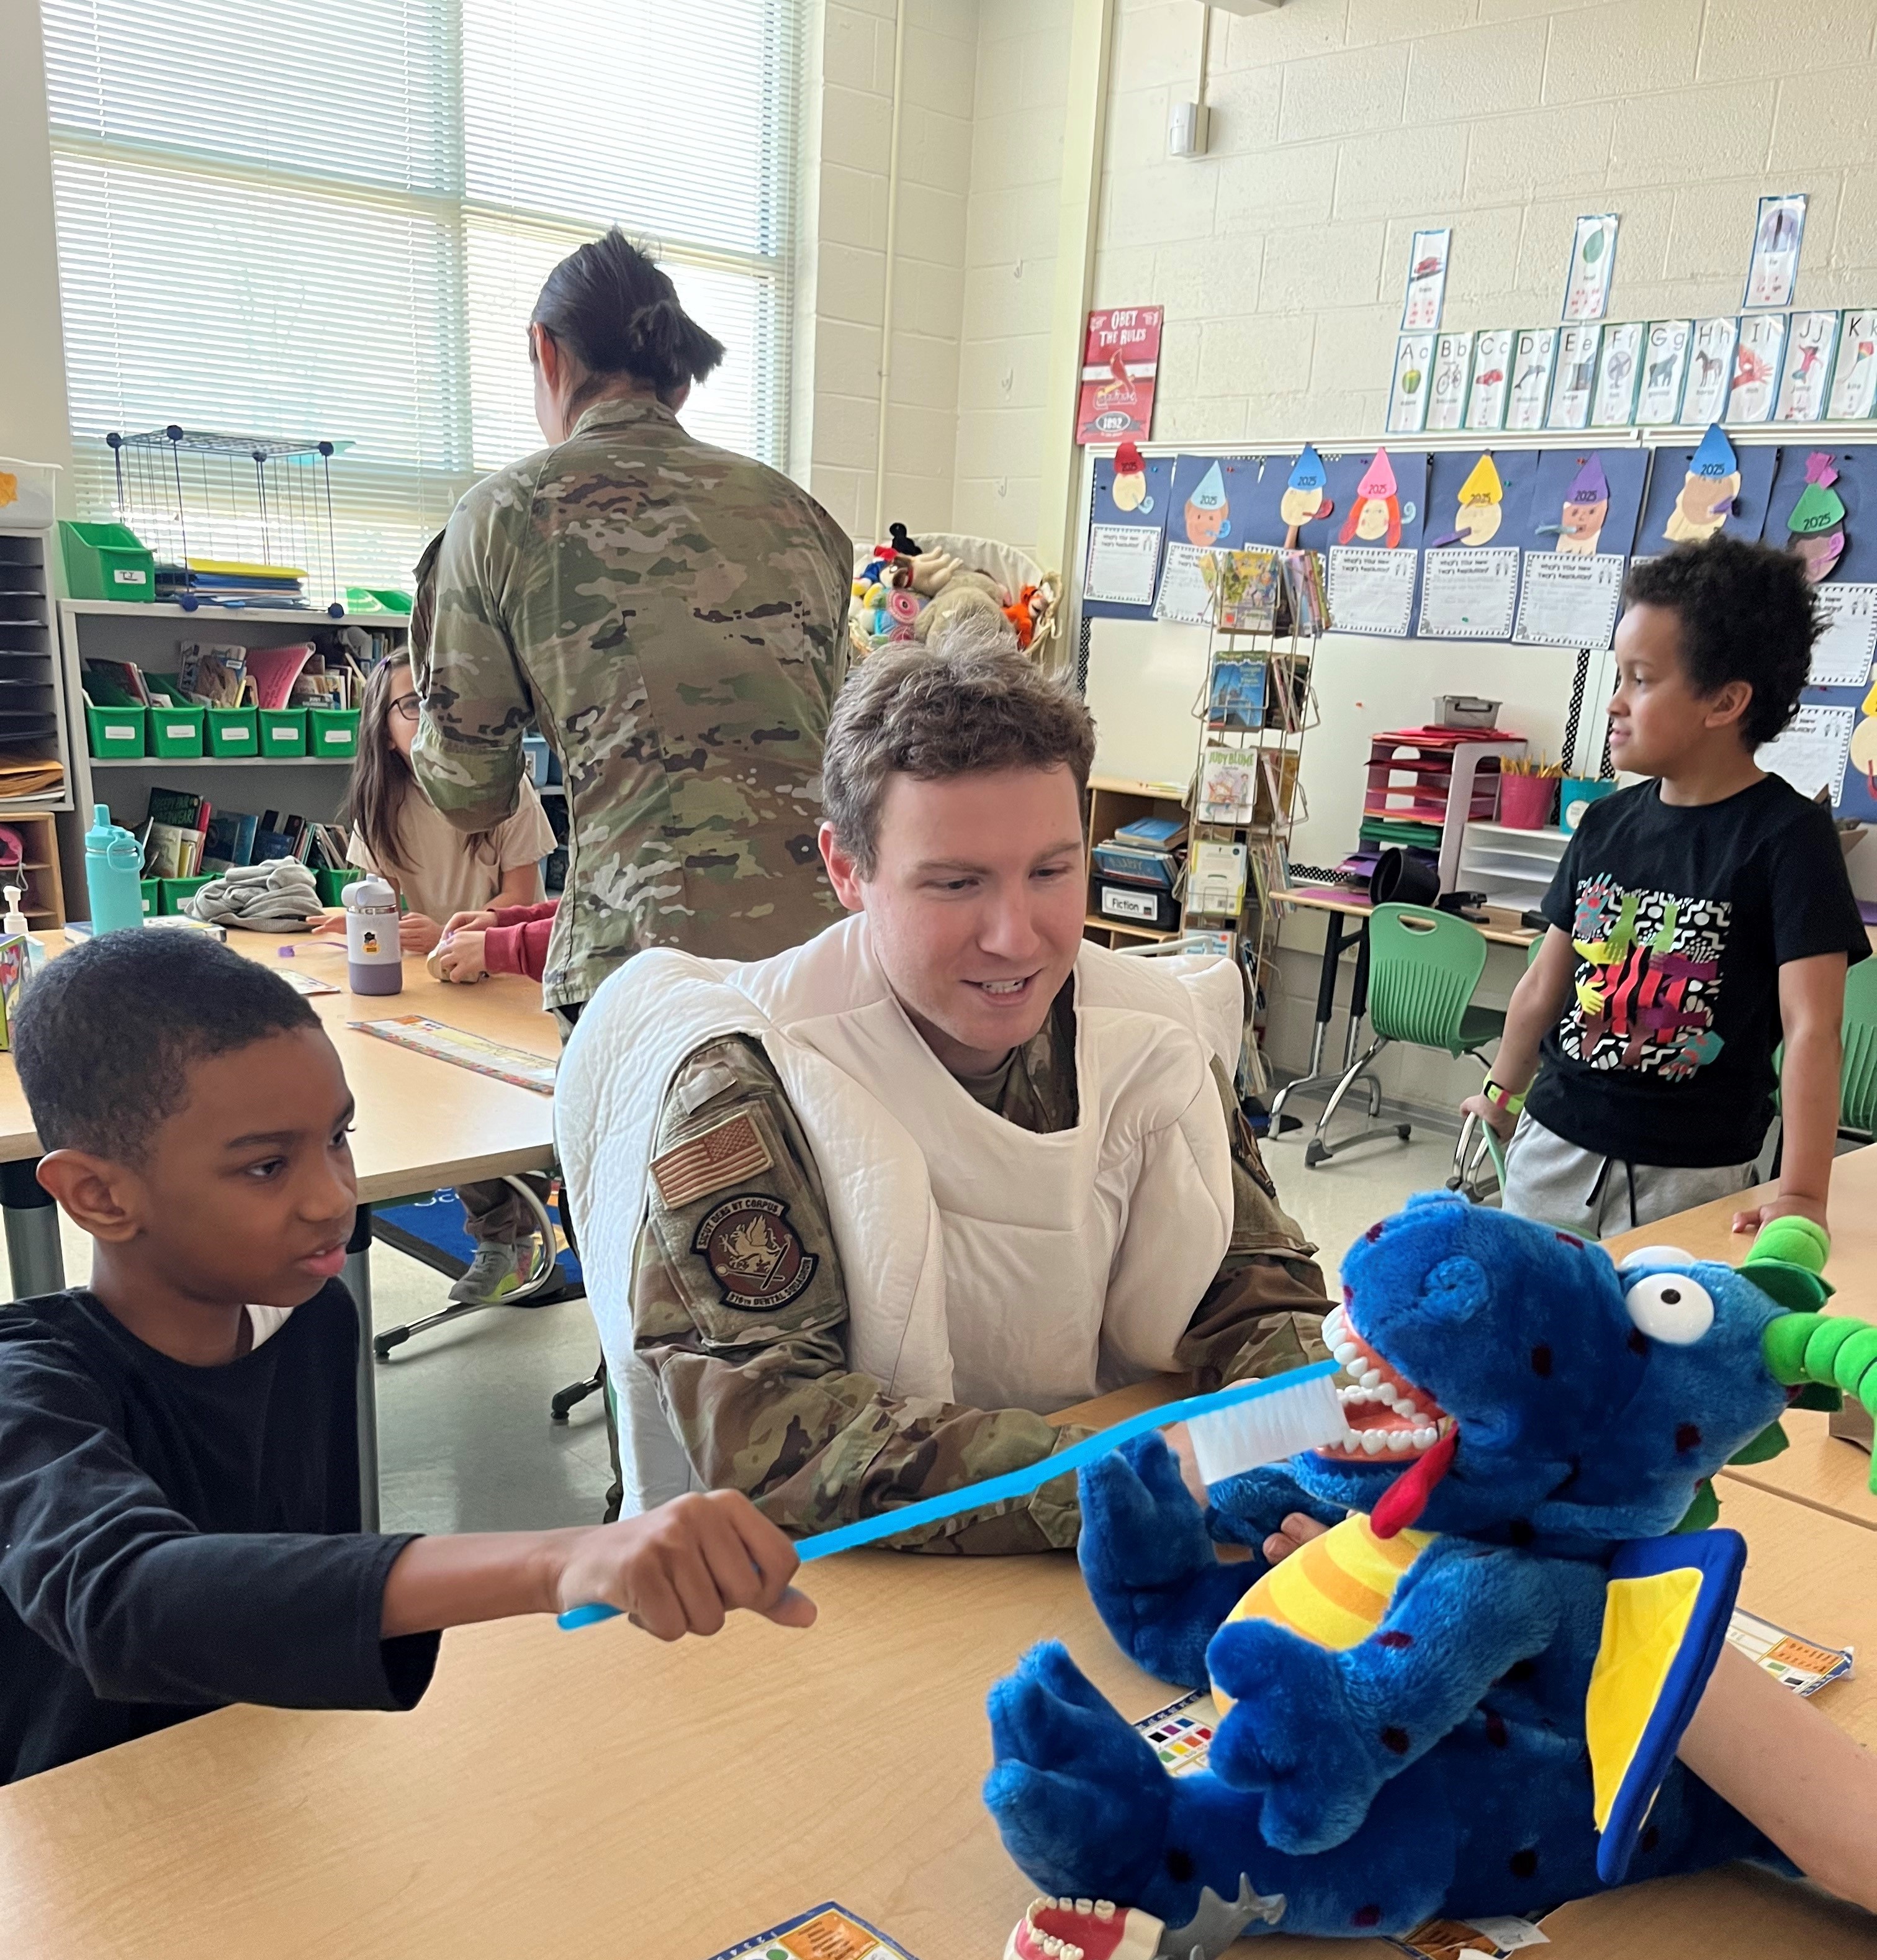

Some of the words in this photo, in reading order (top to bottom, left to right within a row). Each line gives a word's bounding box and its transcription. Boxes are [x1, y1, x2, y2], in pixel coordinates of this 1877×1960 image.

[1111, 310, 1138, 330] OBEY
[1799, 317, 1812, 339] J
[1850, 317, 1861, 338] K
[1100, 331, 1119, 346] THE
[1120, 328, 1146, 345] RULES
[1565, 333, 1576, 351] E
[1582, 338, 1592, 351] e
[1612, 330, 1622, 349] F
[1651, 327, 1668, 346] G
[1673, 331, 1685, 351] g
[1699, 326, 1712, 346] H
[1719, 326, 1730, 344] h
[1400, 344, 1414, 360] A
[1441, 341, 1451, 358] B
[1457, 340, 1468, 357] b
[1480, 338, 1494, 355] C
[1519, 337, 1534, 355] D
[1540, 337, 1551, 354] d
[1103, 417, 1122, 428] 1892
[1701, 464, 1724, 476] 2025
[1297, 476, 1317, 486] 2025
[1368, 484, 1387, 494] 2025
[1574, 490, 1597, 502] 2025
[1803, 512, 1831, 531] 2025
[1209, 752, 1228, 765] JUDY
[1228, 751, 1254, 766] BLUME
[1112, 898, 1139, 912] Fiction
[745, 1199, 778, 1213] CORPUS
[754, 1292, 786, 1305] DENTAL
